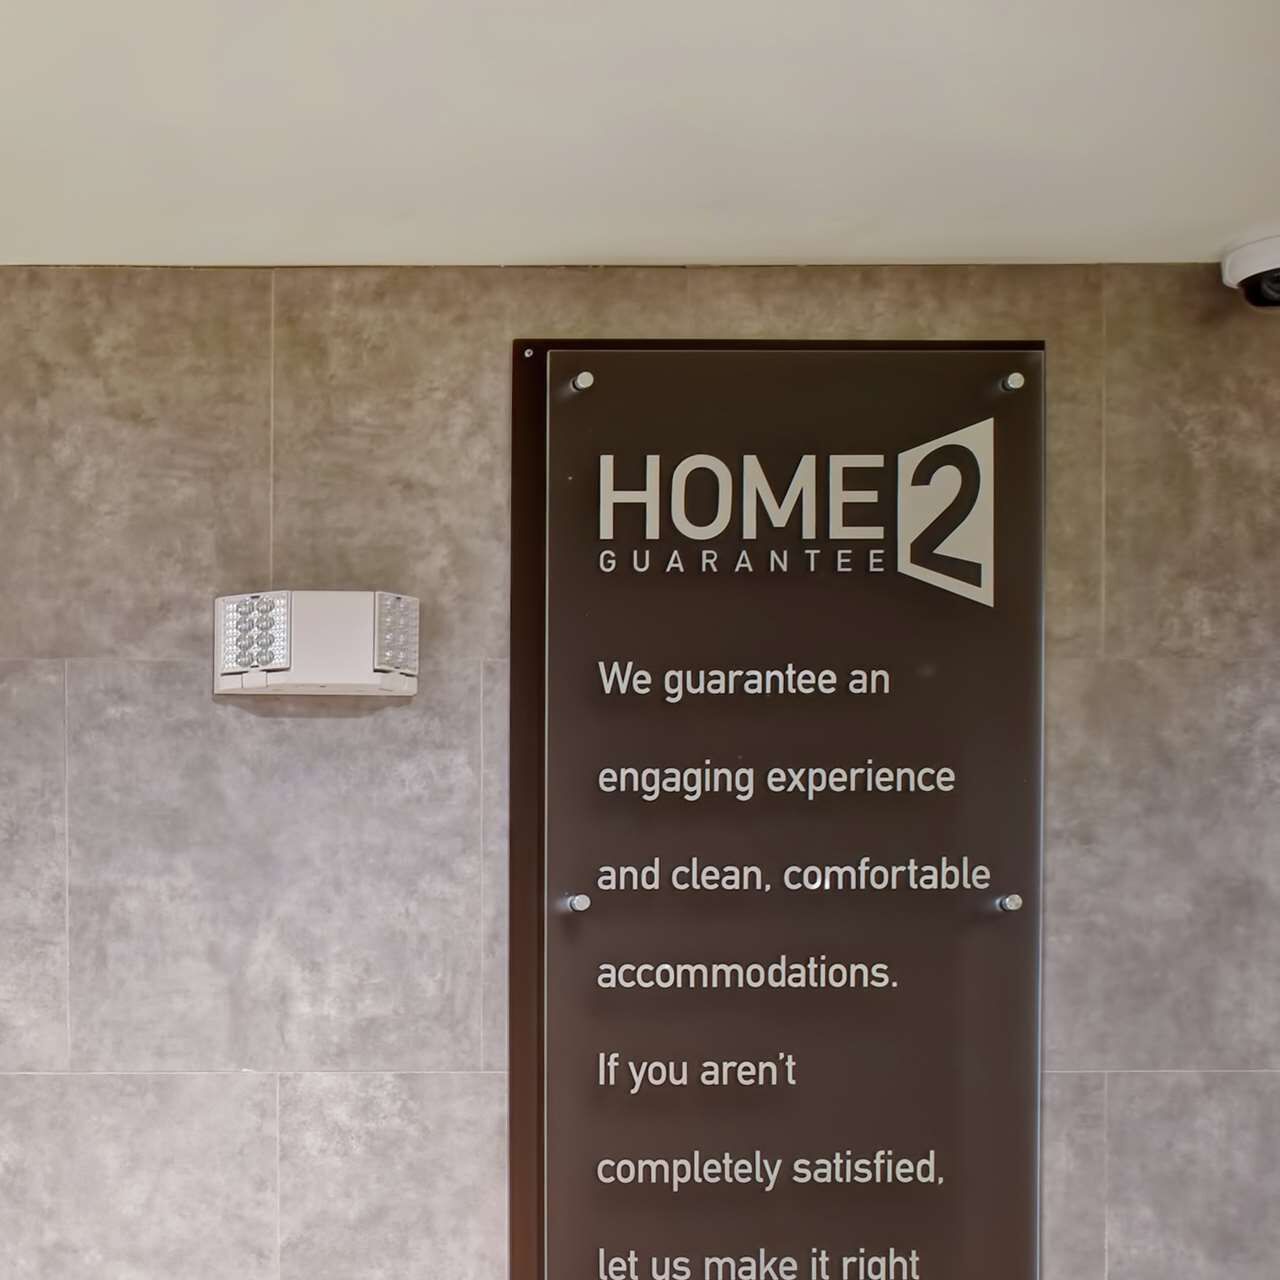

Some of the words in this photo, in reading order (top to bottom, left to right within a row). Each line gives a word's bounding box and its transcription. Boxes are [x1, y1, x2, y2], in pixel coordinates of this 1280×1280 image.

[599, 549, 885, 573] GUARANTEE
[598, 661, 652, 695] We
[664, 663, 837, 703] guarantee
[848, 669, 890, 695] an
[598, 759, 754, 802] engaging
[767, 759, 956, 801] experience
[597, 857, 660, 890] and
[671, 856, 771, 892] clean,
[783, 856, 991, 890] comfortable
[597, 954, 899, 988] accommodations.
[598, 1052, 620, 1086] If
[628, 1061, 689, 1095] you
[700, 1052, 797, 1086] aren't
[597, 1150, 783, 1192] completely
[792, 1149, 945, 1185] satisfied,
[599, 1247, 639, 1280] let
[651, 1256, 691, 1280] us
[704, 1247, 798, 1280] make
[811, 1247, 830, 1280] it
